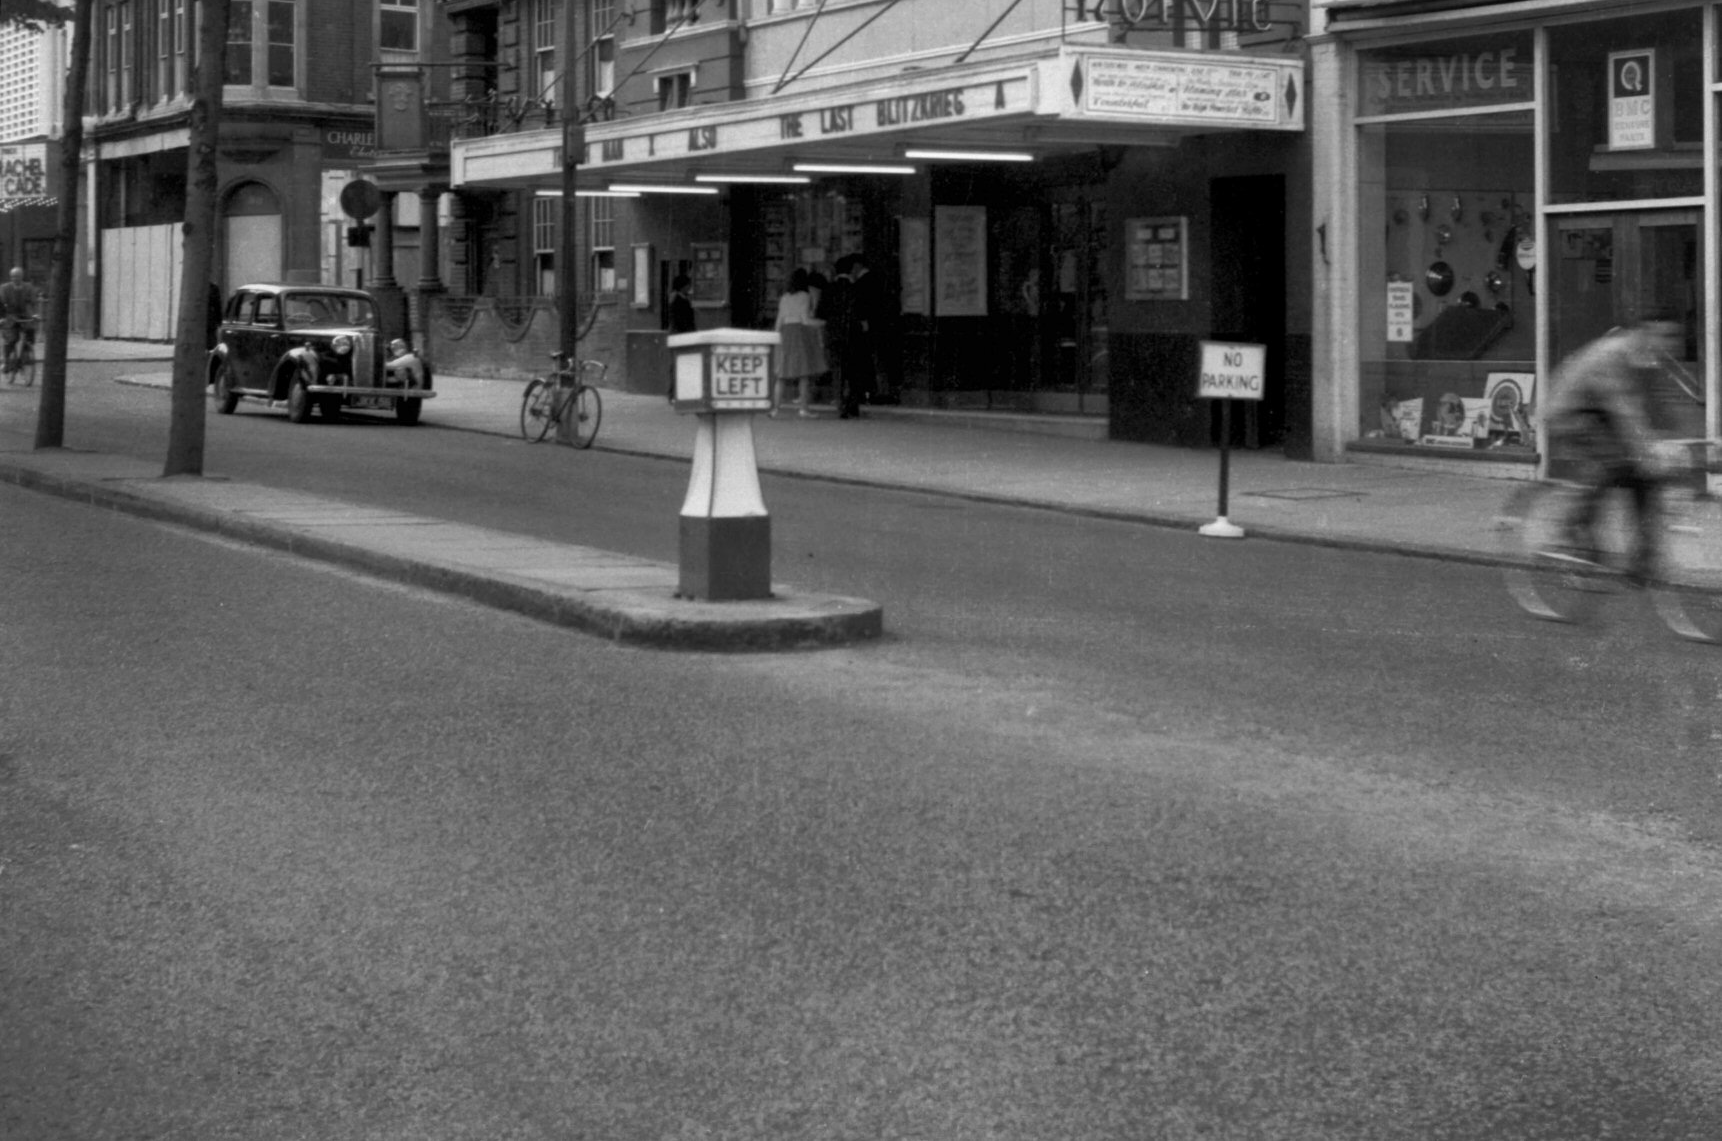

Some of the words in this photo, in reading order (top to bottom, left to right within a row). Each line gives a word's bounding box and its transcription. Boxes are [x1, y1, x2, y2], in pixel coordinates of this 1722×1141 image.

[1377, 47, 1518, 99] SERVICE
[779, 113, 803, 140] THE
[820, 106, 855, 134] LAST
[876, 89, 965, 128] BLITZKRIEG
[994, 80, 1006, 110] A
[5, 177, 41, 196] CADE
[716, 356, 763, 374] KEEP
[1223, 351, 1243, 368] NO
[716, 377, 763, 395] LEFT
[1202, 372, 1259, 391] PARKING
